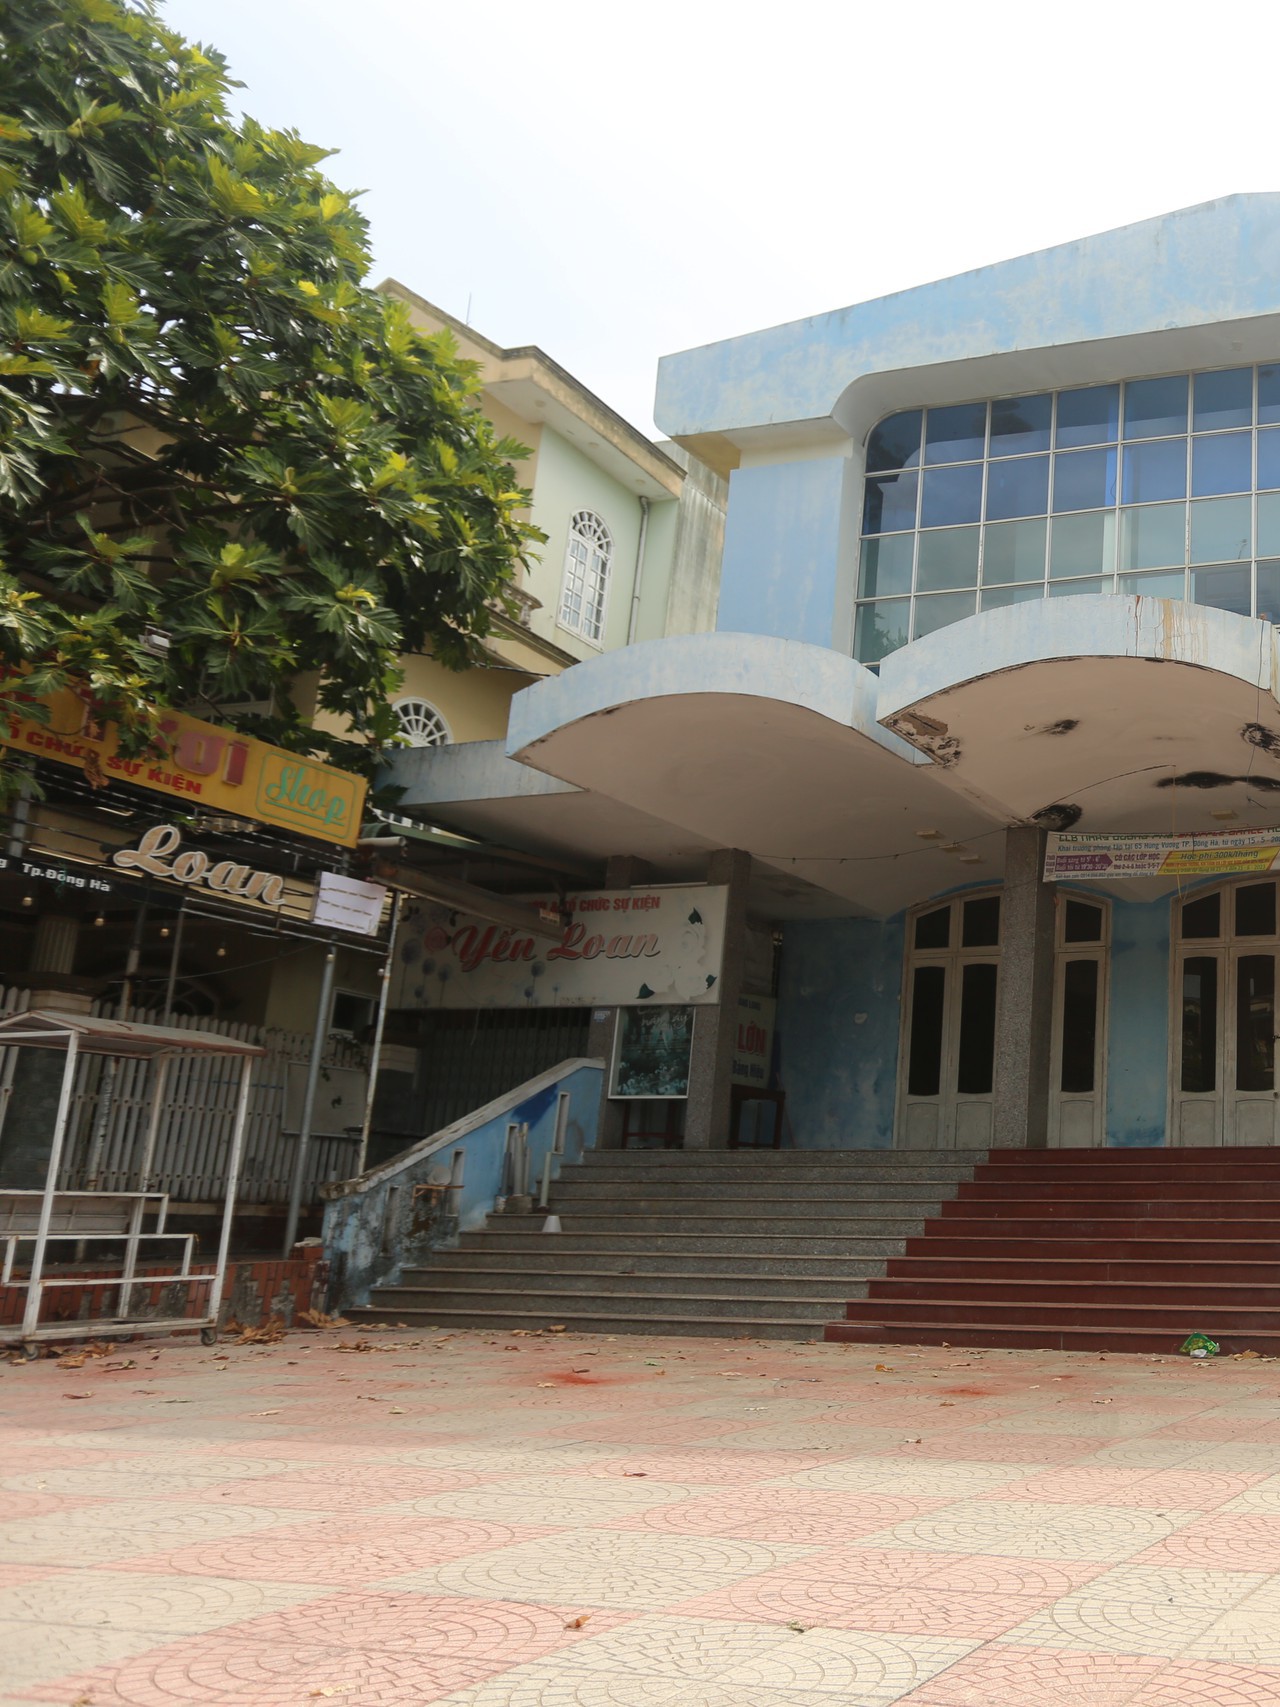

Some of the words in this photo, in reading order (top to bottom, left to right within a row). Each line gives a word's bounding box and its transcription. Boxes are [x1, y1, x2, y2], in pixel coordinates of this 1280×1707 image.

[106, 756, 145, 777] SỰ
[147, 767, 202, 795] KIỆN
[266, 767, 346, 824] Shop
[89, 879, 111, 892] Hà
[113, 825, 285, 905] Loan
[579, 896, 611, 912] CHỨC
[613, 897, 631, 913] SỰ
[632, 894, 661, 912] KIỆN
[452, 925, 537, 972] Yến
[546, 921, 661, 960] Loan
